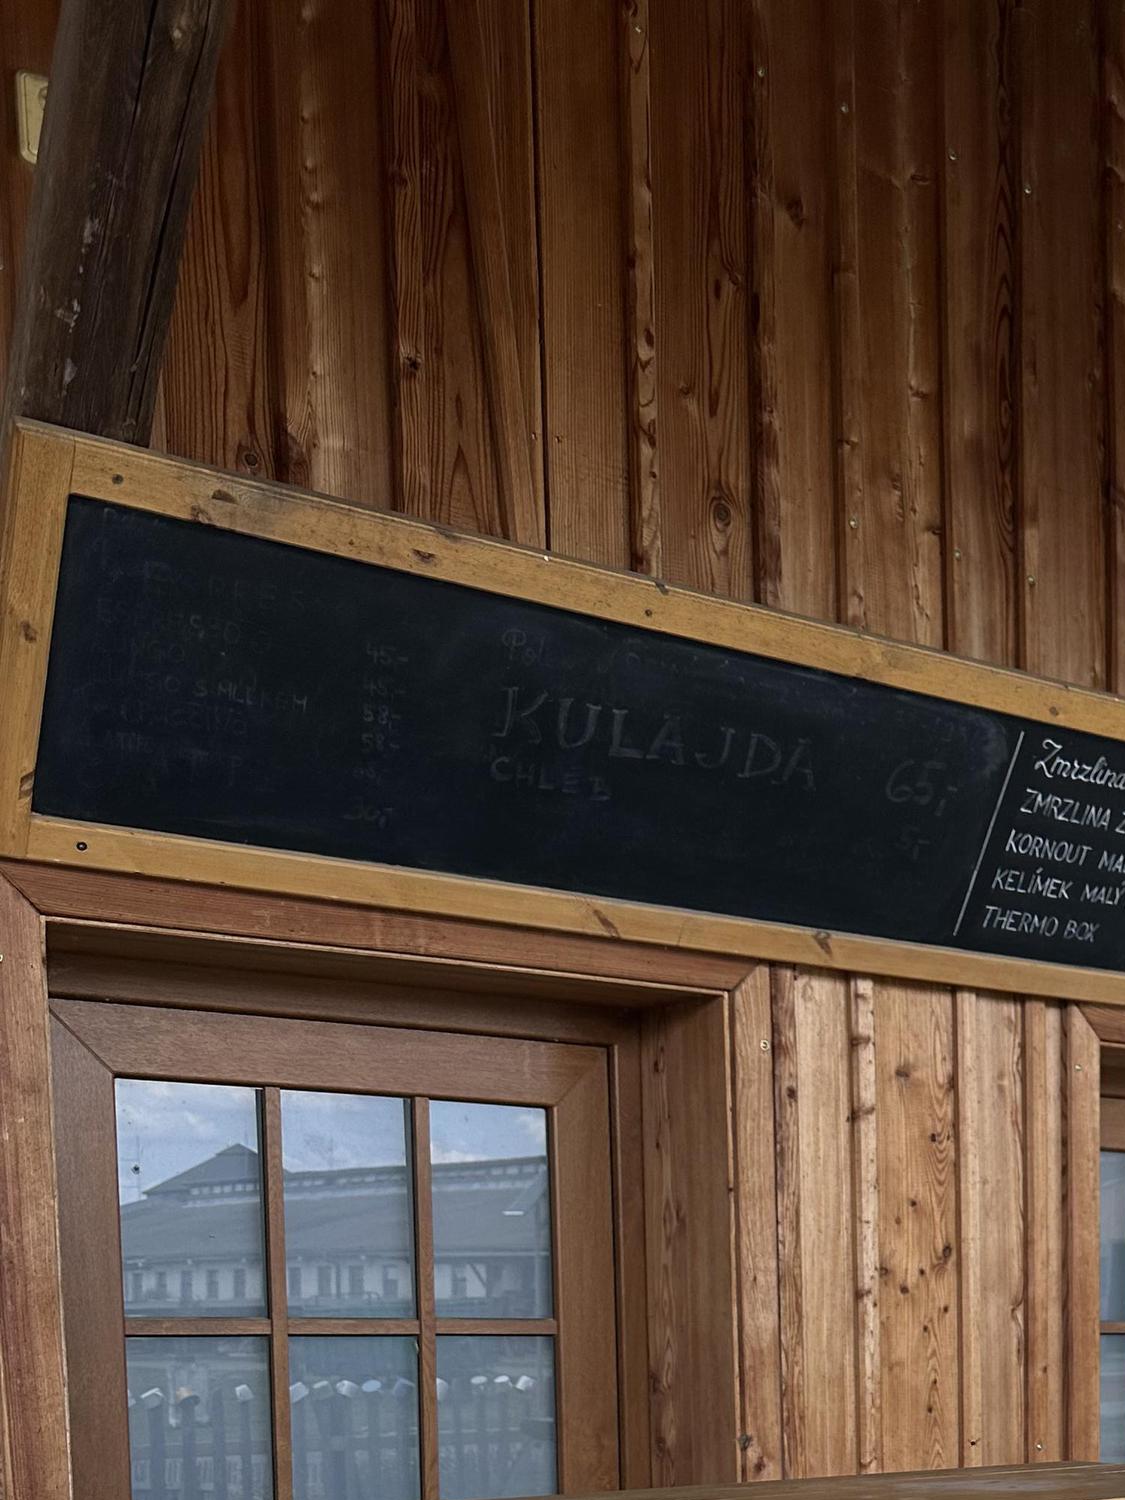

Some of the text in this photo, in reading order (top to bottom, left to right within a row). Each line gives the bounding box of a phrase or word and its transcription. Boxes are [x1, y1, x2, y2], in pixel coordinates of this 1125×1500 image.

[493, 686, 817, 792] KULAJDA
[1020, 788, 1112, 830] ZMRZLINA
[1005, 828, 1093, 866] KORNOUT
[991, 867, 1073, 901] KELÍMEK
[982, 905, 1060, 937] THERMO
[1064, 919, 1101, 943] BOX
